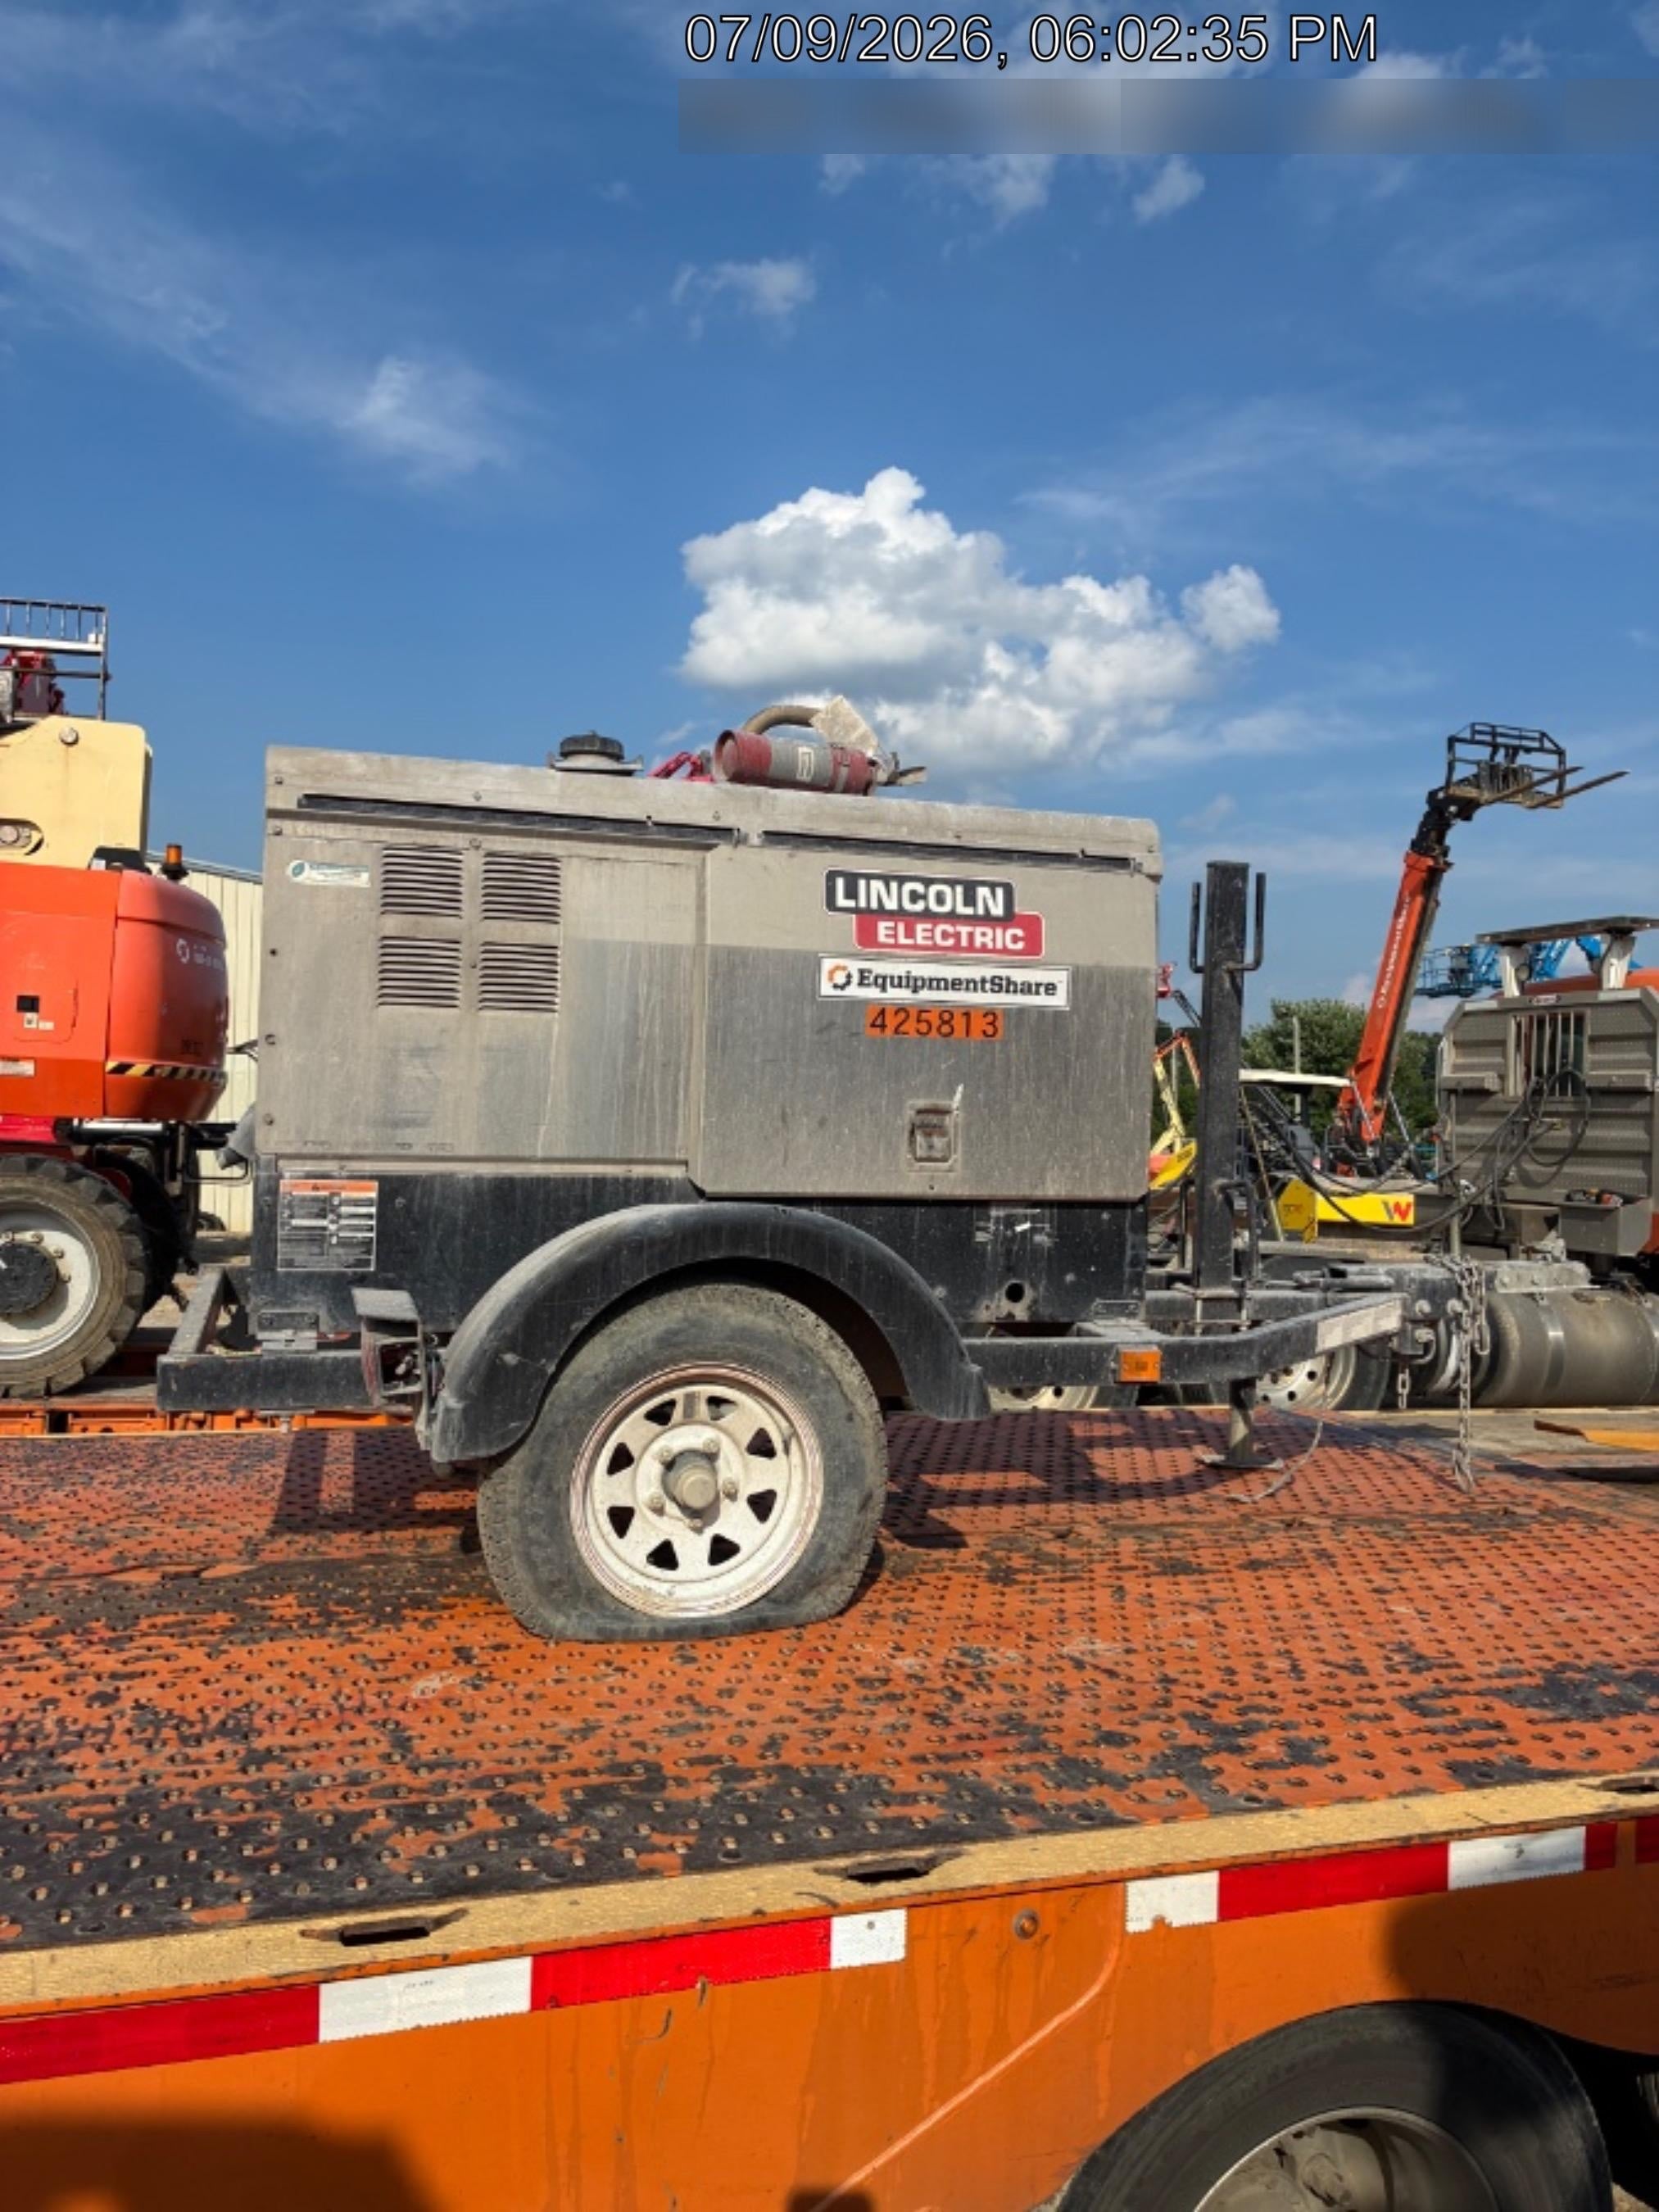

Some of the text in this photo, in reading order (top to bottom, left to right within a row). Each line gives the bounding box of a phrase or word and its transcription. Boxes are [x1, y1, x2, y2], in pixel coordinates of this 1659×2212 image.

[834, 877, 1005, 918] LINCOLN
[876, 921, 1025, 950] ELECTRIC
[857, 968, 1058, 996] EquipmentShare
[869, 1007, 999, 1038] 425813
